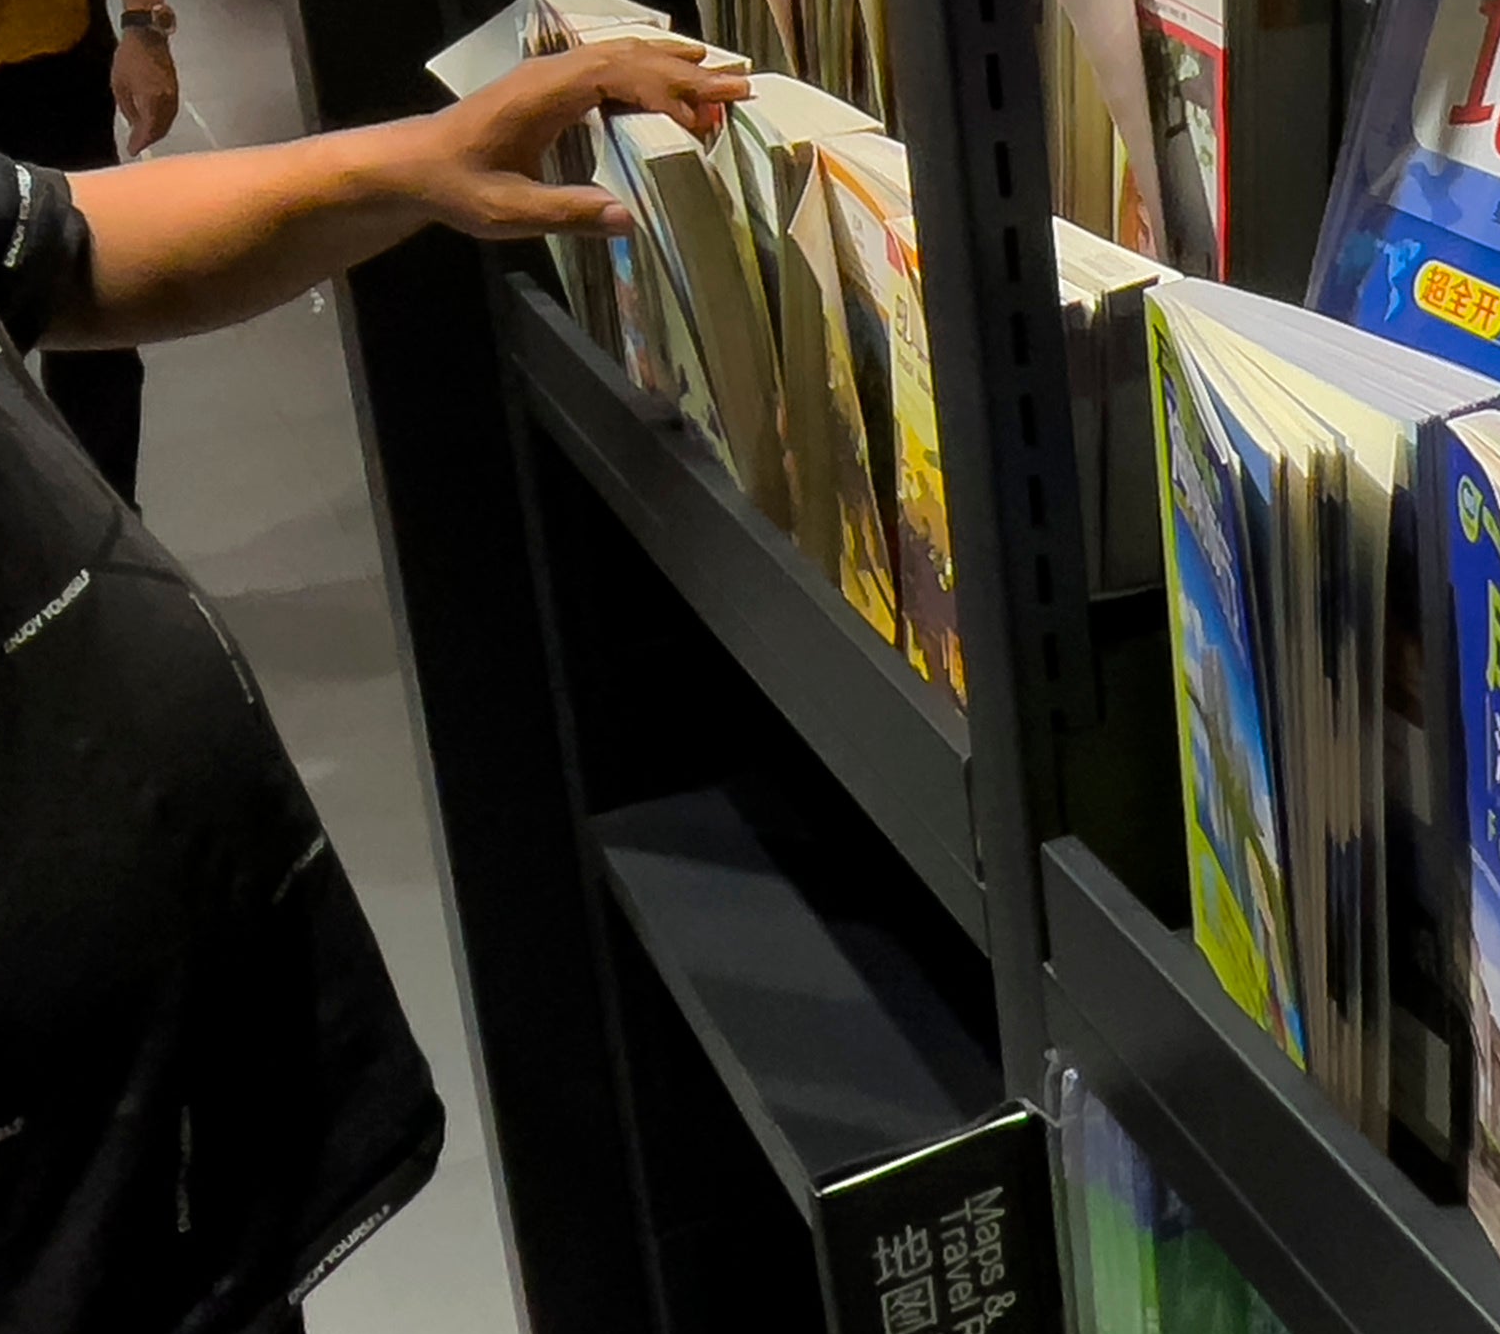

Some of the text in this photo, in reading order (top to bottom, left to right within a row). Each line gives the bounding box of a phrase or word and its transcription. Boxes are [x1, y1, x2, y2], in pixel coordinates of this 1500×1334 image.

[1420, 265, 1500, 331] 超全开
[940, 1198, 982, 1314] Travel
[964, 1185, 1018, 1320] Maps &
